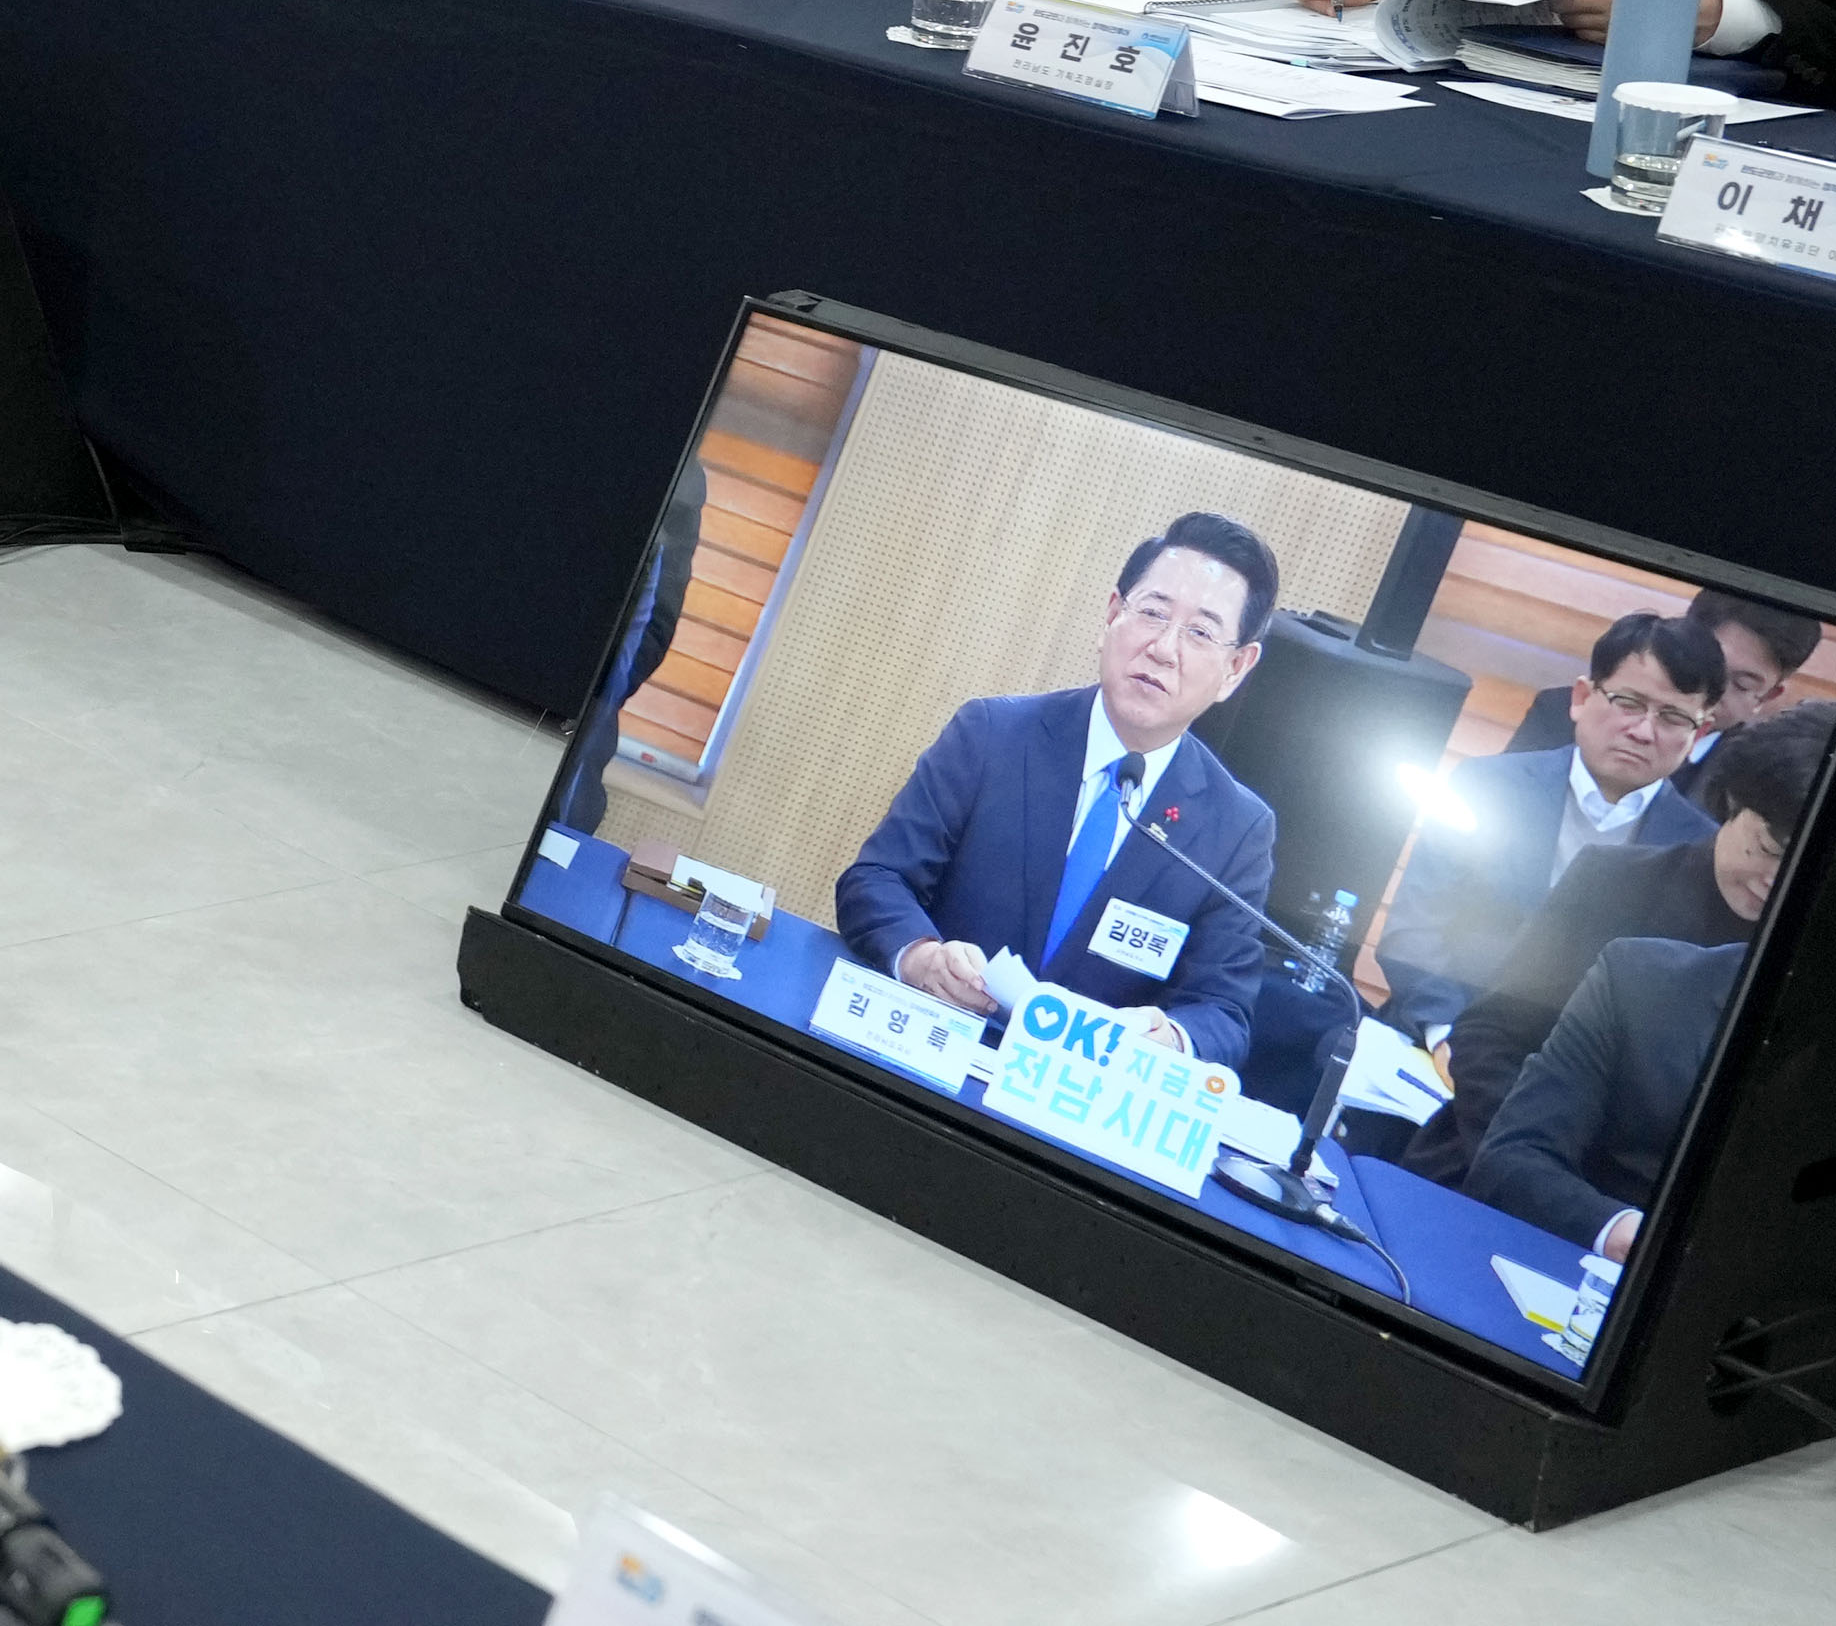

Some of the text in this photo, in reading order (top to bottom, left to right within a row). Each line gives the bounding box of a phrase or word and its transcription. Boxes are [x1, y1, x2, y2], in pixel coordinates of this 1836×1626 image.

[1108, 919, 1169, 958] 김영록
[1000, 1041, 1214, 1173] 전남시대
[1022, 994, 1127, 1068] OK!
[1125, 1047, 1226, 1114] 지금은
